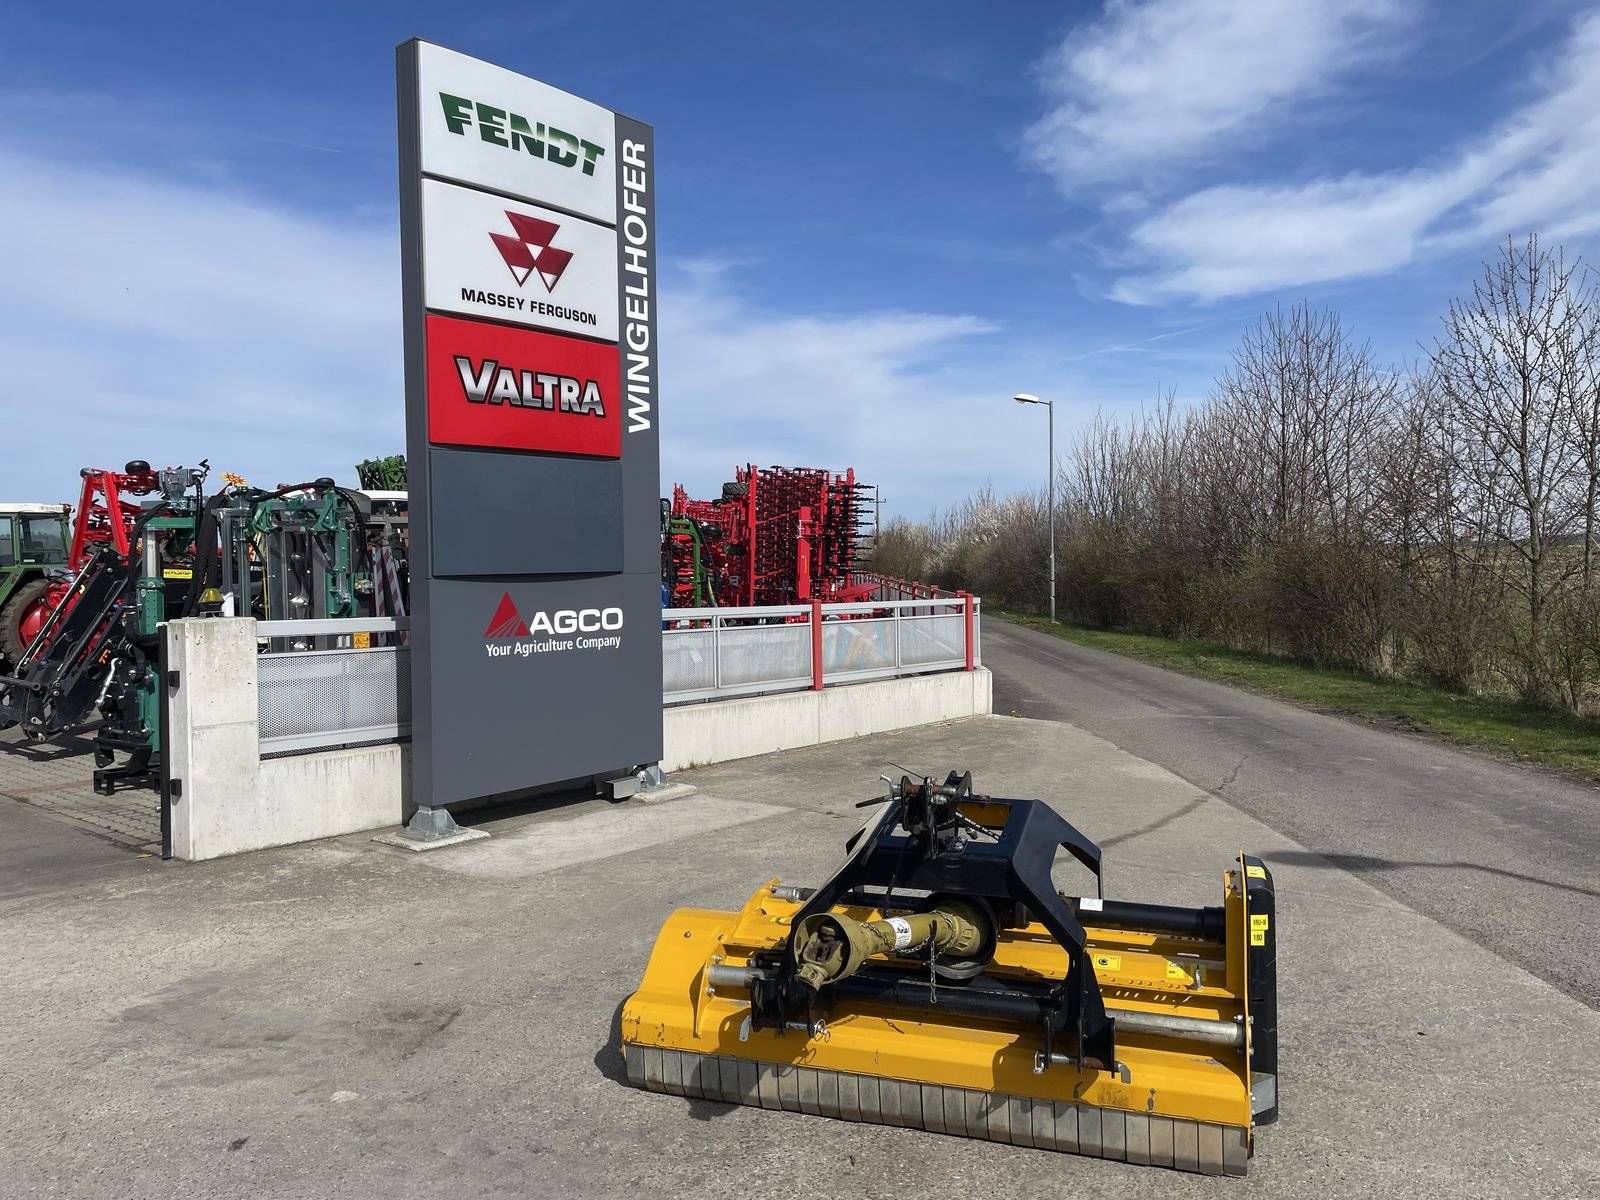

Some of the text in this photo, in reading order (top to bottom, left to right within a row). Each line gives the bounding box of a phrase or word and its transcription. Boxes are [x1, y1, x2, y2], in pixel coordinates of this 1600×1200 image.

[439, 91, 605, 176] FENDT
[622, 138, 651, 433] WINGELHOFER
[461, 288, 597, 326] MASSEY FERGUSON
[453, 355, 606, 418] VALTRA
[529, 607, 624, 636] AGCO
[485, 636, 621, 657] Your Agriculture Company
[1253, 933, 1263, 941] 180
